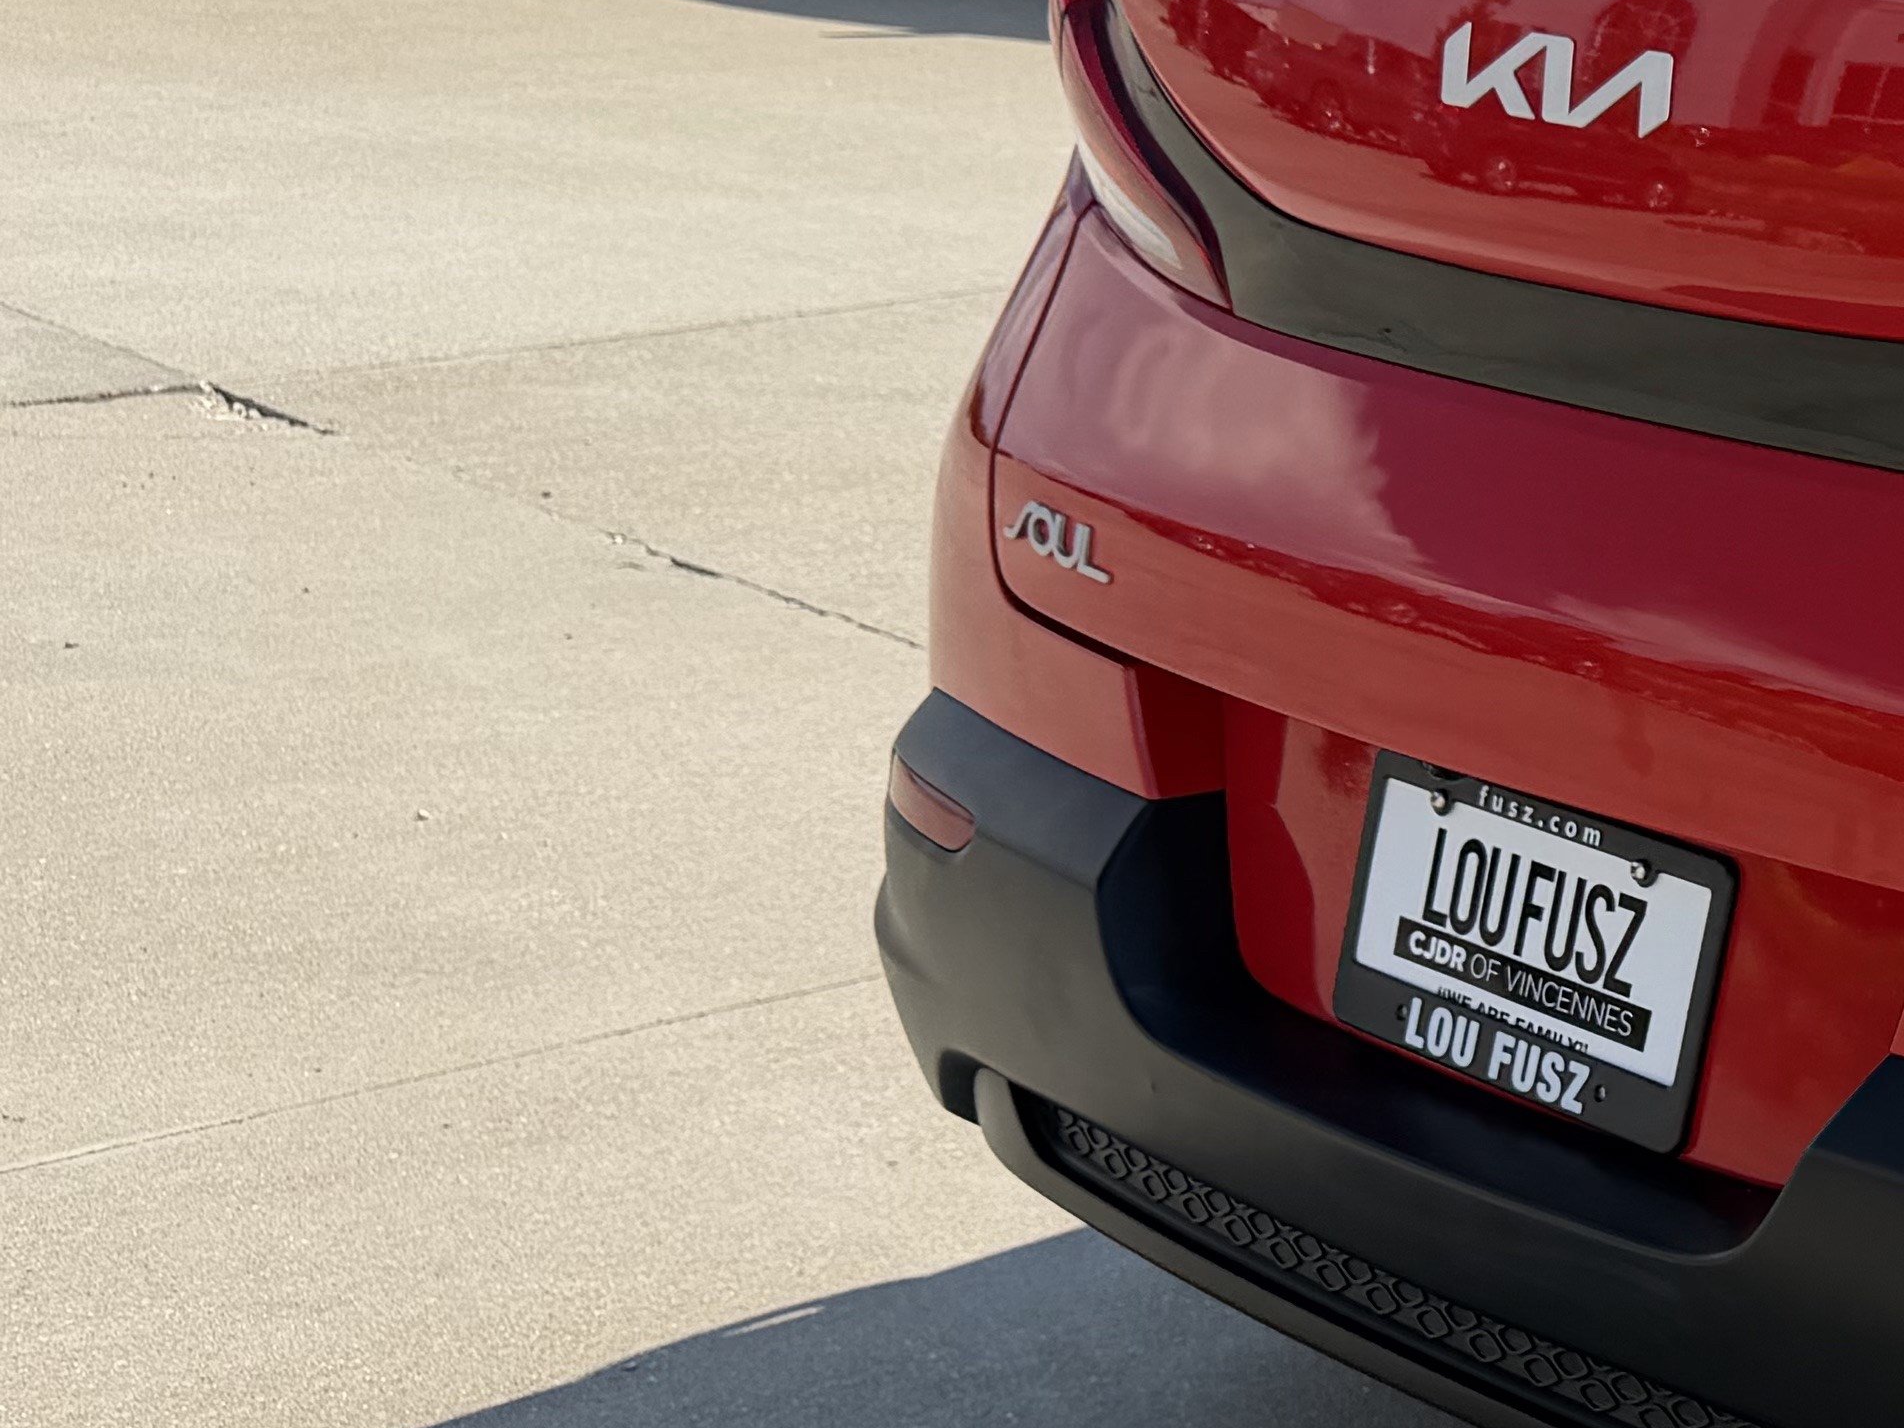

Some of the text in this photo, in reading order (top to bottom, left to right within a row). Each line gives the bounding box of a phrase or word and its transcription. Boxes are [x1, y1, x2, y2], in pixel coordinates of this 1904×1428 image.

[1441, 21, 1674, 139] KIA
[1003, 500, 1112, 584] SOUL
[1480, 785, 1600, 847] fusz.com
[1409, 931, 1633, 1037] CJDR OF VINCENNES
[1405, 997, 1591, 1115] LOU FUSZ
